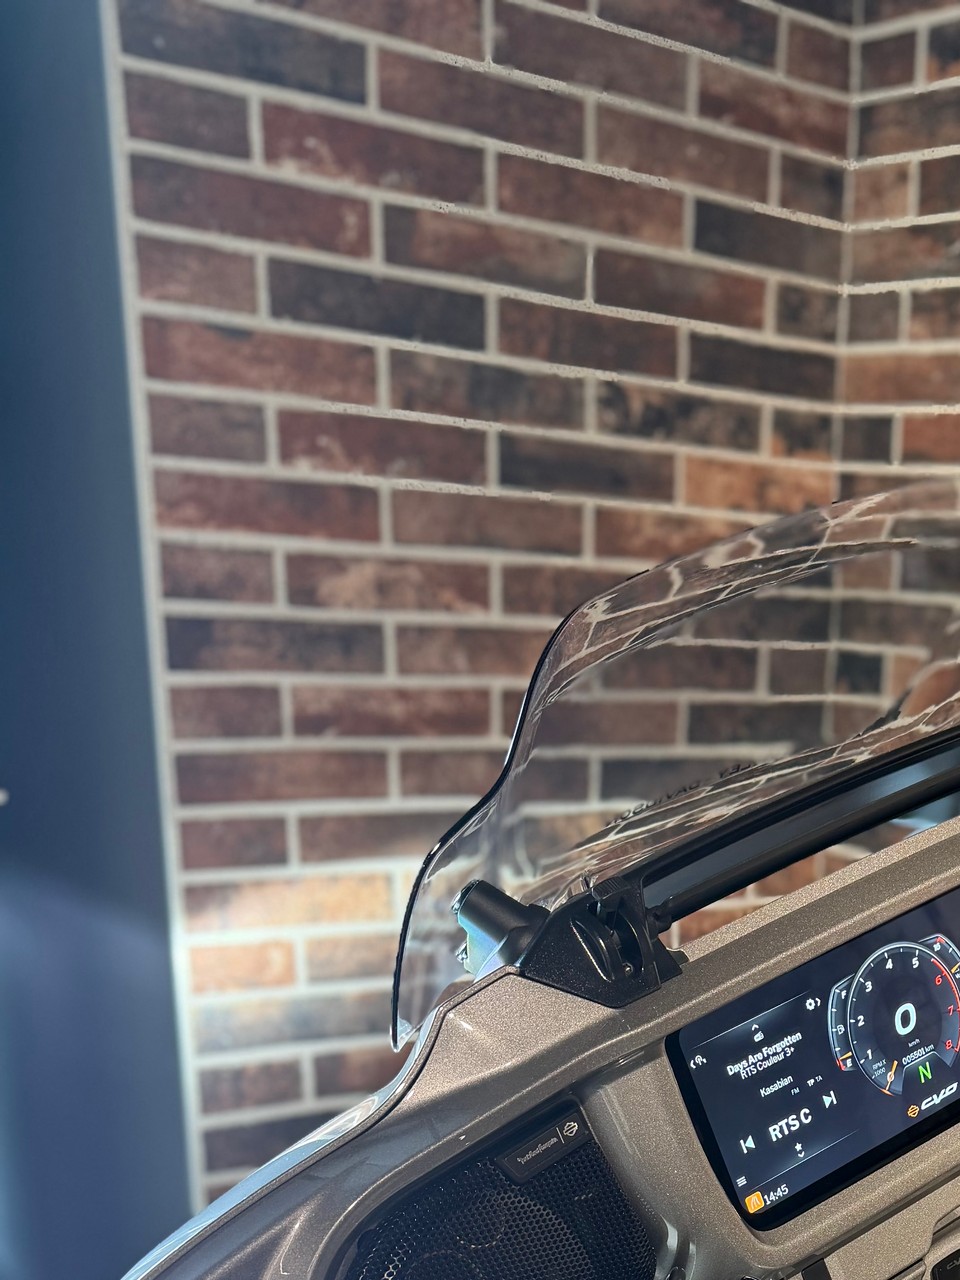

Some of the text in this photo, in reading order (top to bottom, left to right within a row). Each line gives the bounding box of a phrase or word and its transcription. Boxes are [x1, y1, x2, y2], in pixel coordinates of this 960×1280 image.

[885, 958, 893, 970] 4
[912, 957, 920, 969] 5
[934, 974, 943, 986] 6
[864, 981, 873, 992] 3
[841, 990, 847, 1000] F
[947, 1005, 954, 1016] 7
[857, 1015, 865, 1027] 2
[894, 1002, 917, 1036] 0
[925, 1043, 935, 1053] km
[945, 1039, 953, 1051] 8
[726, 1032, 802, 1076] Days Are Forgotten
[866, 1048, 873, 1060] 1
[740, 1046, 796, 1080] RTS Couleur 3+
[846, 1058, 853, 1068] E
[918, 1061, 932, 1084] N
[759, 1075, 794, 1098] Kasabian
[790, 1086, 800, 1096] FM
[920, 1081, 959, 1111] CVO
[768, 1107, 813, 1142] RTS C
[763, 1183, 789, 1206] 14:45
